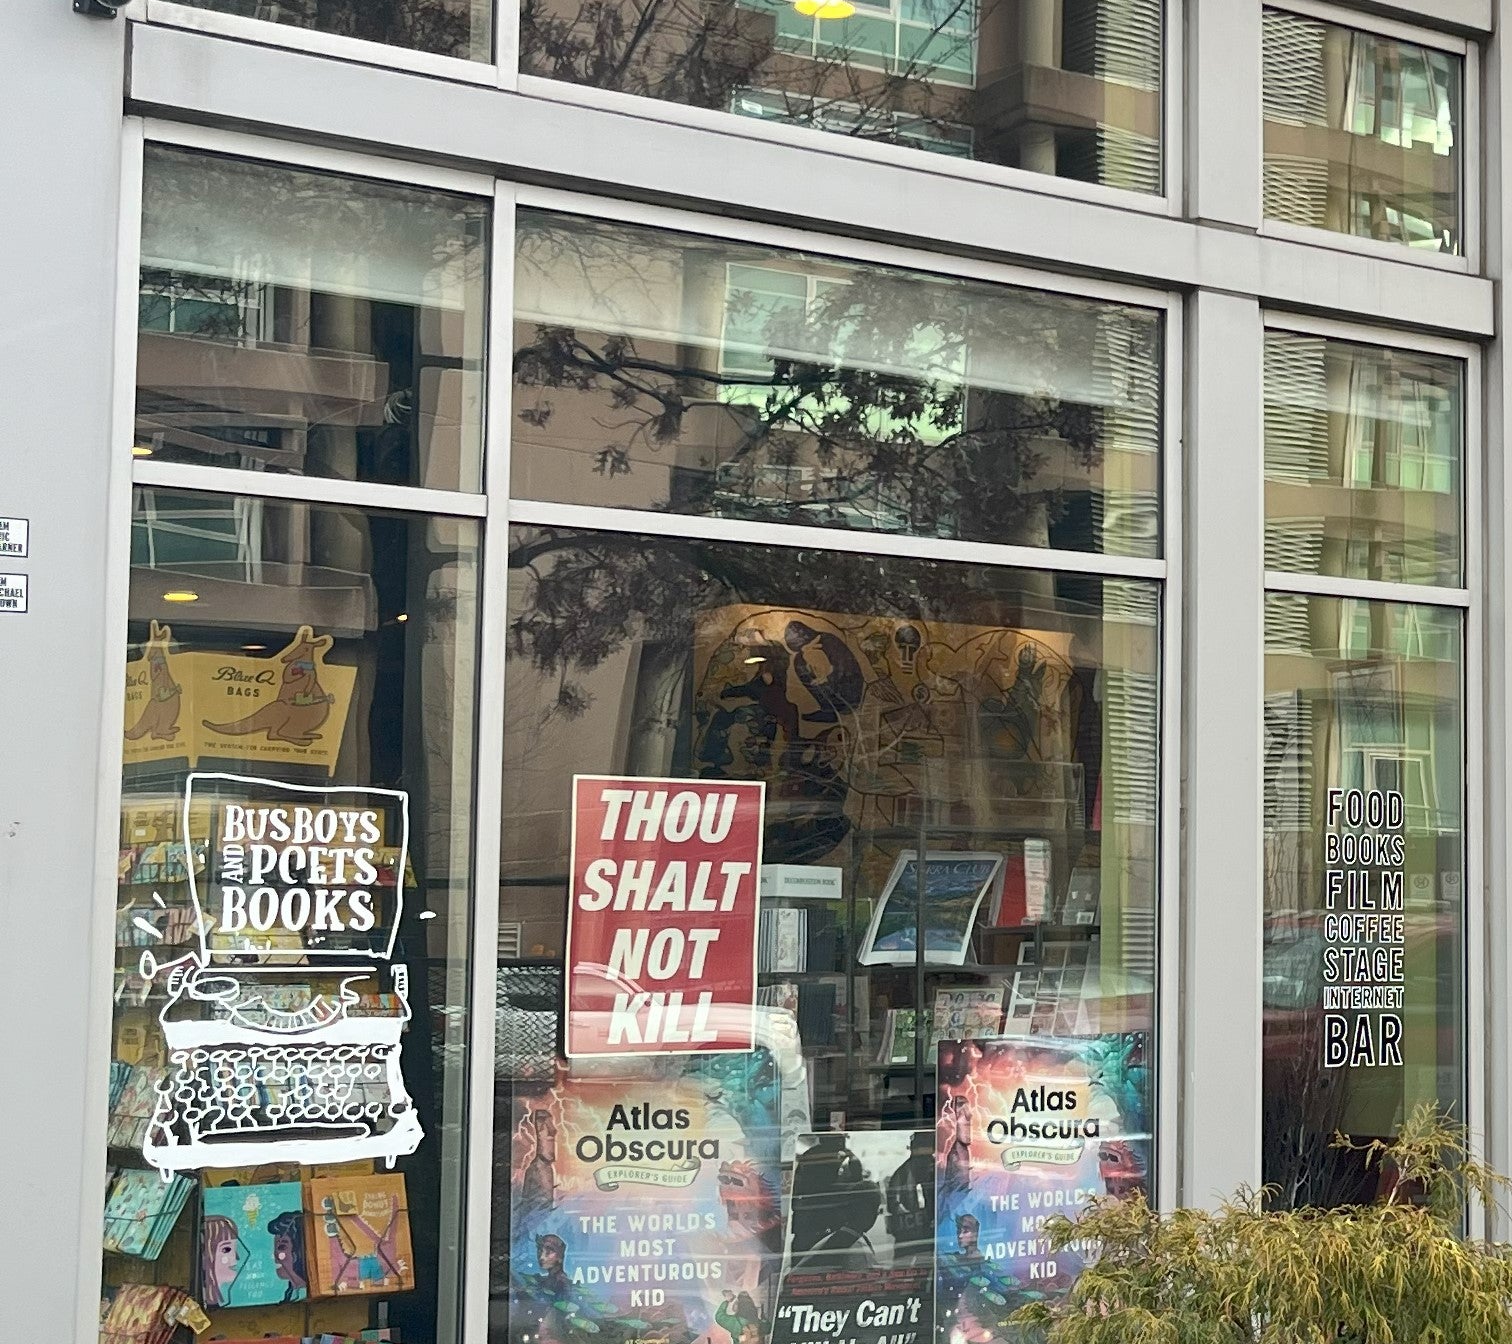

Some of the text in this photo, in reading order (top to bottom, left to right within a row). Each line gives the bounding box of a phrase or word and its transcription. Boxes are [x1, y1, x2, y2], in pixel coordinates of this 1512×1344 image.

[227, 686, 260, 698] BAGS
[254, 670, 277, 686] Q
[600, 789, 739, 844] THOU
[1326, 787, 1404, 830] FOOD
[222, 805, 381, 844] BUSBOYS
[1325, 832, 1405, 866] BOOKS
[221, 843, 378, 886] AND POETS
[906, 862, 951, 876] SRRA
[578, 858, 752, 912] SHALT
[1325, 869, 1404, 911] FILM
[218, 886, 376, 933] BOOKS
[1324, 913, 1405, 944] COFFEE
[605, 927, 721, 980] NOT
[1323, 947, 1405, 983] STAGE
[1322, 986, 1405, 1010] INTERNET
[606, 991, 719, 1045] KILL
[1324, 1013, 1404, 1068] BAR
[1010, 1085, 1077, 1114] Atlas
[606, 1102, 690, 1131] Atlas
[986, 1116, 1100, 1144] Obscura
[575, 1133, 720, 1163] Obscura
[607, 1169, 689, 1183] EXPLORER'S GUIDE
[990, 1193, 1020, 1213] THE
[579, 1215, 617, 1234] THE
[620, 1238, 676, 1257] MOST
[984, 1238, 1104, 1260] ADVENTOU
[572, 1261, 722, 1285] ADVENTUROUS
[1029, 1260, 1057, 1280] KID
[630, 1288, 666, 1307] KID
[778, 1297, 922, 1338] "They Can't
